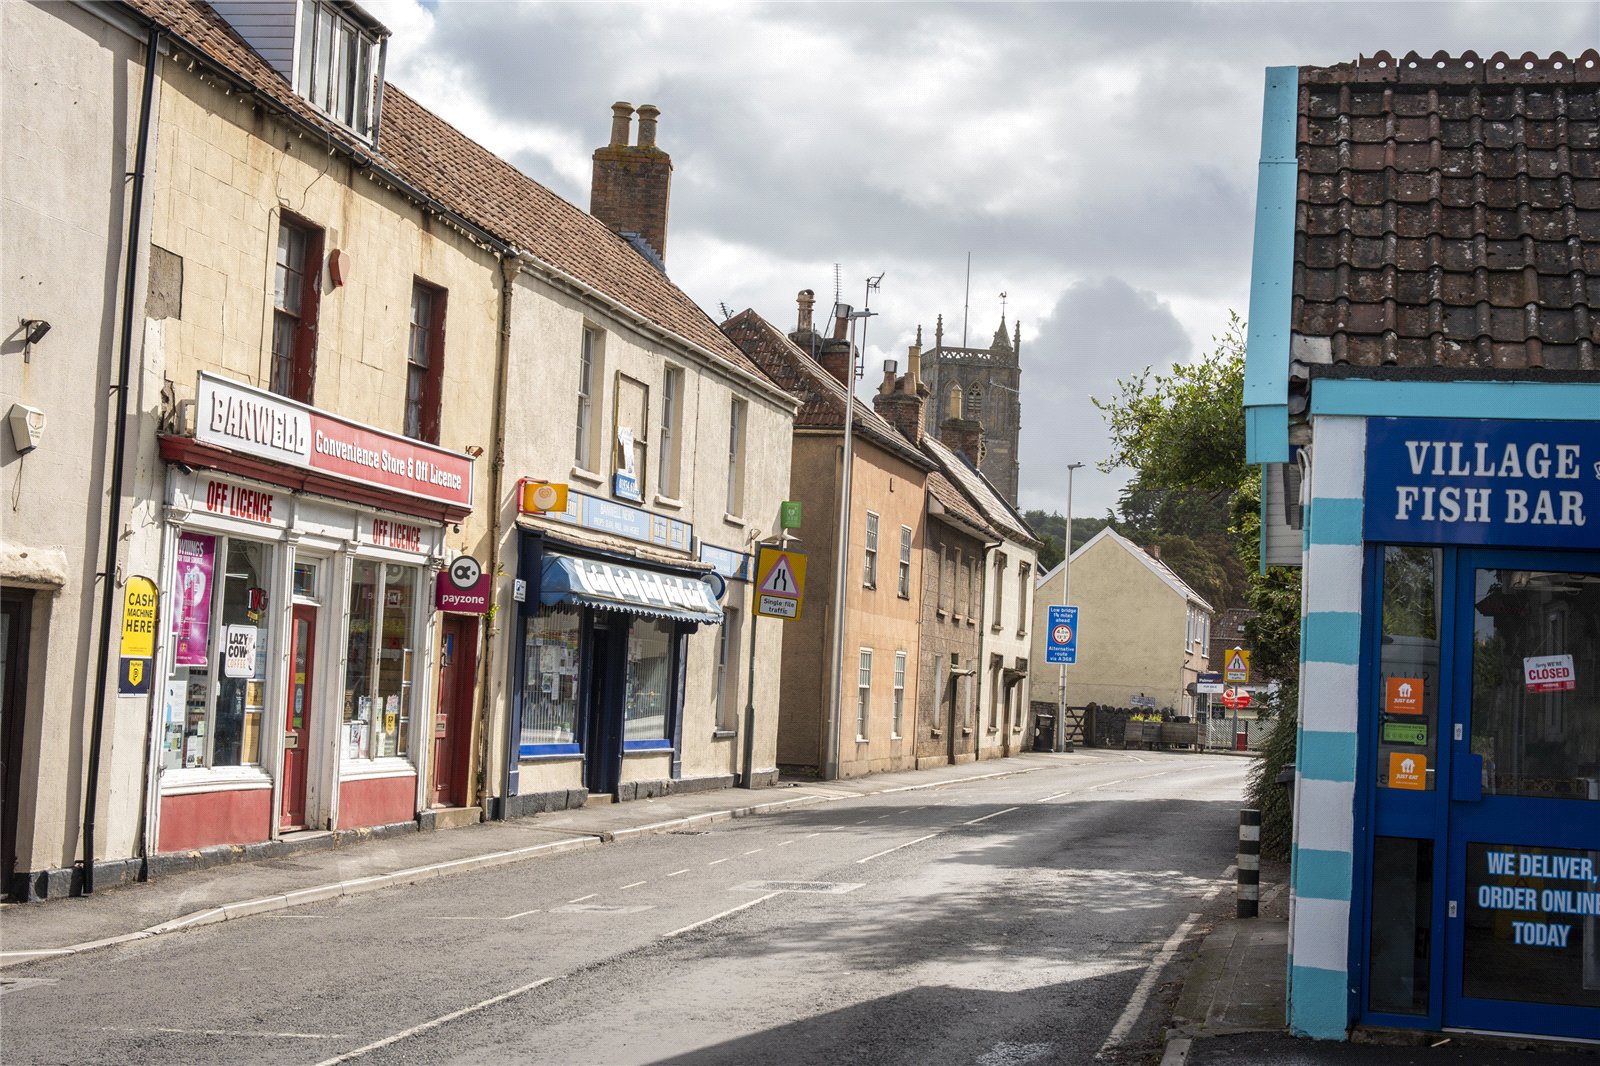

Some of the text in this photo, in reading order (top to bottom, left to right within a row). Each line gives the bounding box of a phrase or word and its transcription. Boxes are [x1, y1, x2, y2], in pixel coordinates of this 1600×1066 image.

[210, 391, 305, 455] BANWELL
[315, 430, 462, 490] Convenience Store & Off Licence
[1405, 441, 1580, 479] VILLAGE
[206, 480, 273, 523] OFF LICENCE
[1395, 486, 1586, 526] FISH BAR
[372, 518, 421, 552] OFF LICENCE
[128, 592, 154, 607] CASH
[442, 593, 485, 606] payzone
[764, 598, 783, 606] Single
[127, 608, 153, 619] MACHINE
[768, 606, 788, 614] traffic
[126, 619, 152, 633] HERE
[230, 632, 248, 645] LAZY
[228, 645, 247, 658] COW
[227, 660, 246, 669] COFFEE
[1528, 667, 1570, 681] CLOSED
[1487, 851, 1599, 884] WE DELIVER,
[1478, 885, 1538, 912] ORDER
[1512, 921, 1571, 948] TODAY
